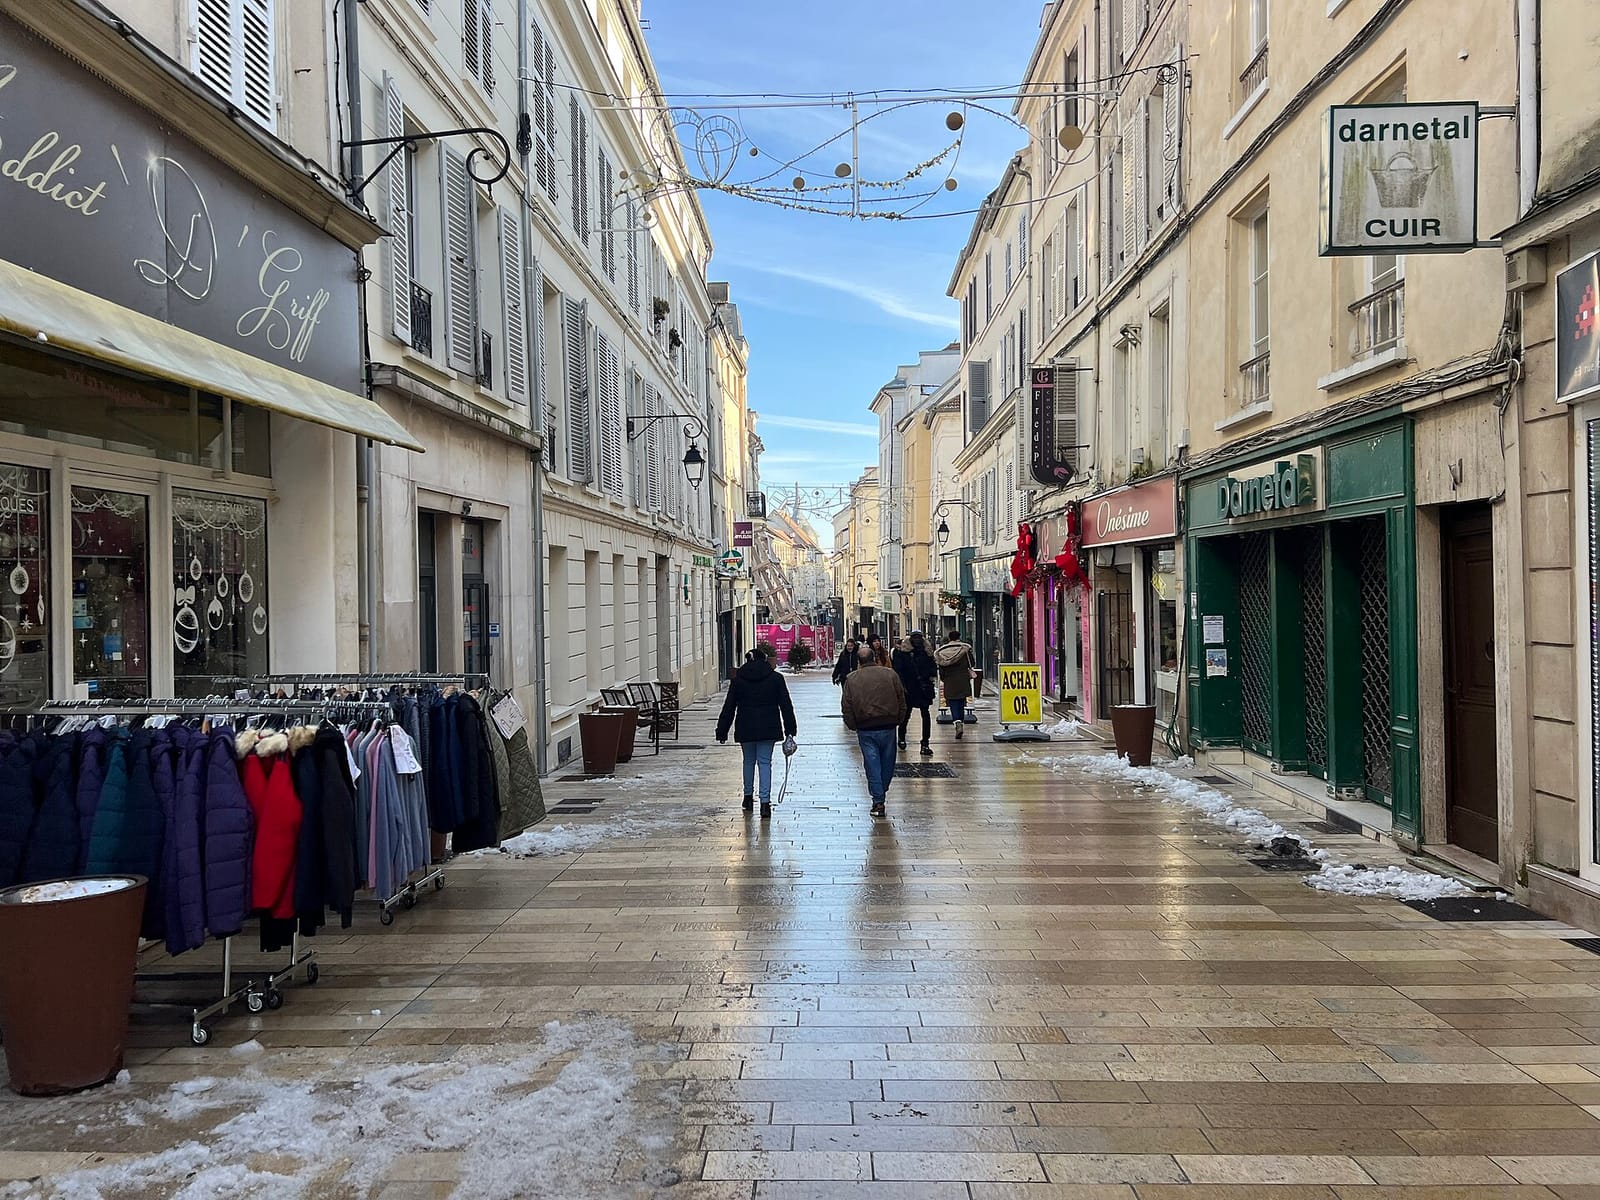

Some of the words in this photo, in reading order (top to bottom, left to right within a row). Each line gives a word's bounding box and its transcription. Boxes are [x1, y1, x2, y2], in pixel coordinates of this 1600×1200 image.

[0, 64, 106, 216] ddict
[1338, 115, 1470, 143] darnetal
[1365, 218, 1441, 238] CUIR
[1097, 500, 1150, 538] Onésime
[1002, 671, 1039, 690] ACHAT
[1013, 696, 1029, 715] OR
